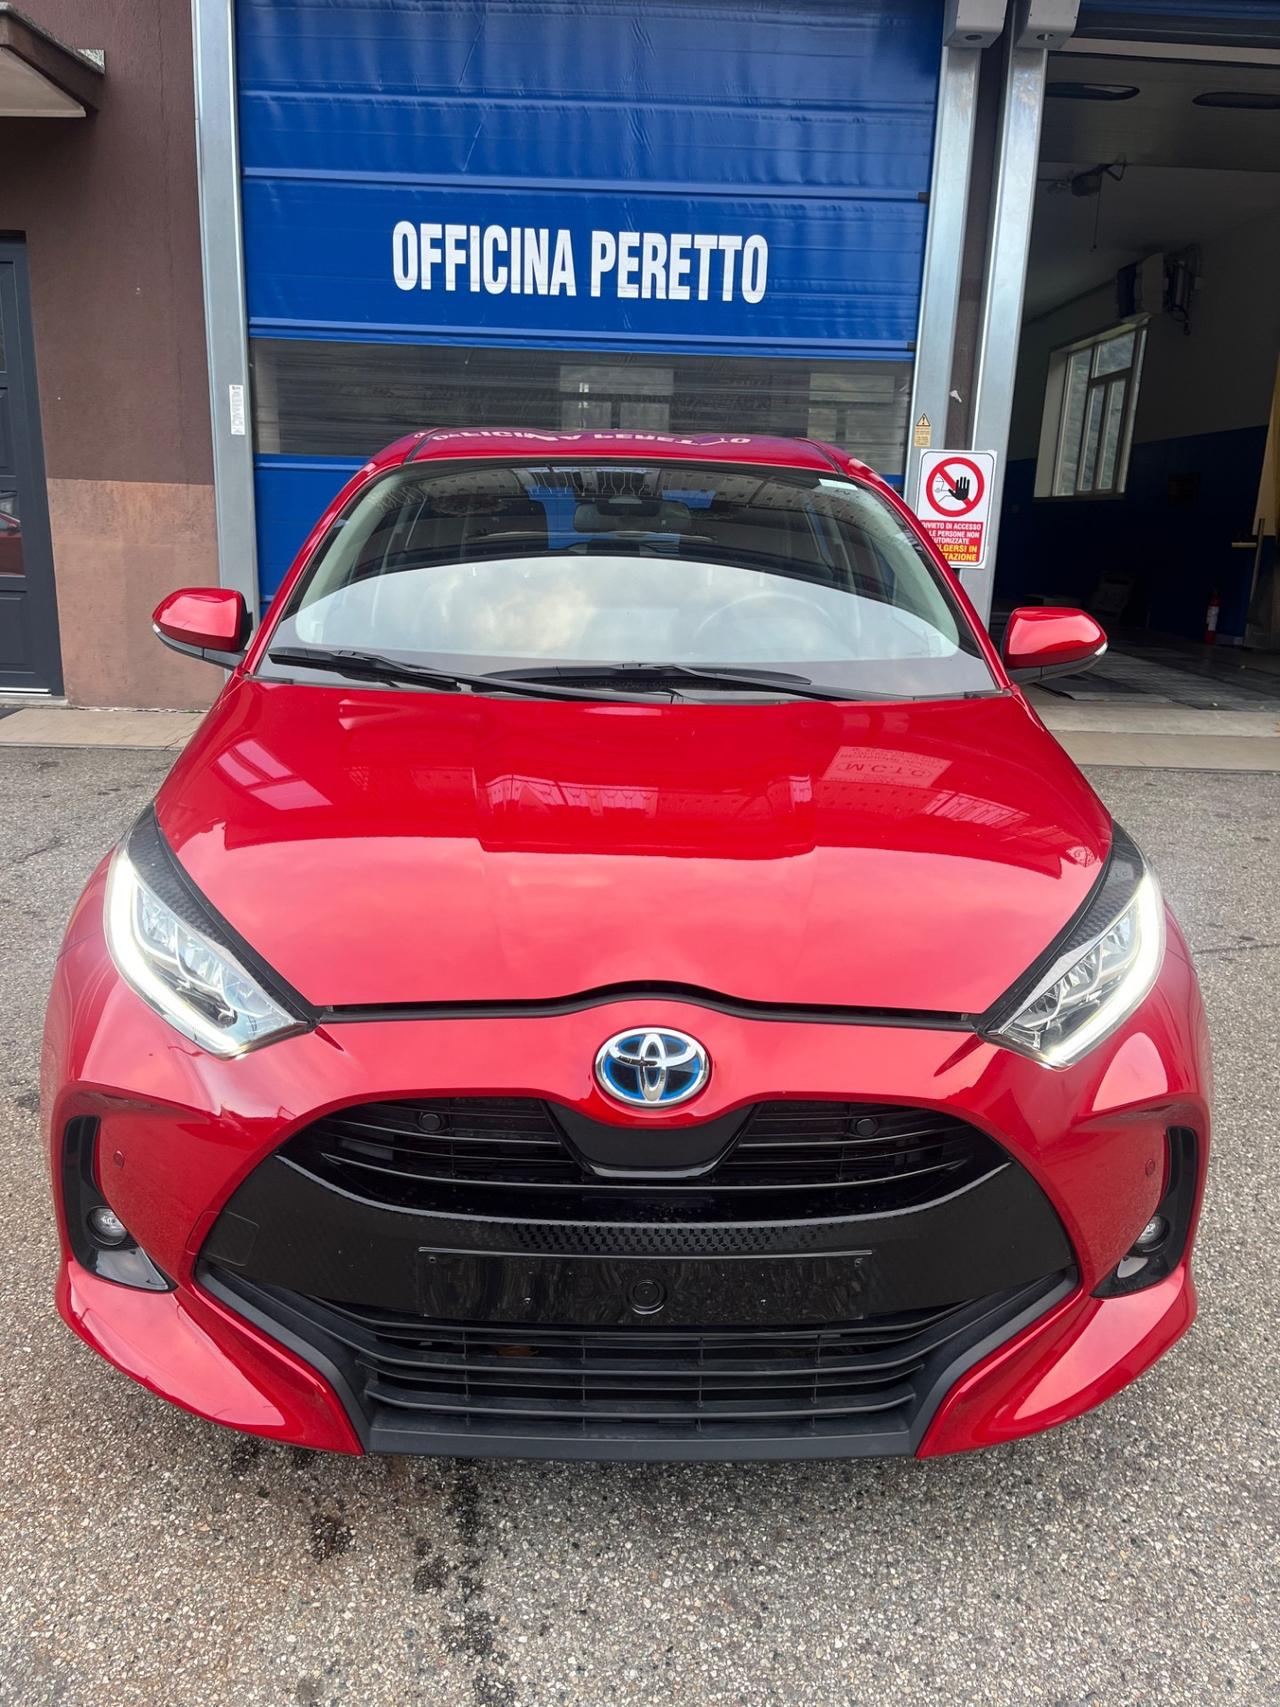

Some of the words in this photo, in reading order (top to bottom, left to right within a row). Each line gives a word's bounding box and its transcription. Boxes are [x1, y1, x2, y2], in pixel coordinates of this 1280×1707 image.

[392, 220, 577, 297] OFFICINA
[590, 230, 769, 304] PERETTO
[938, 544, 967, 552] LGERSI
